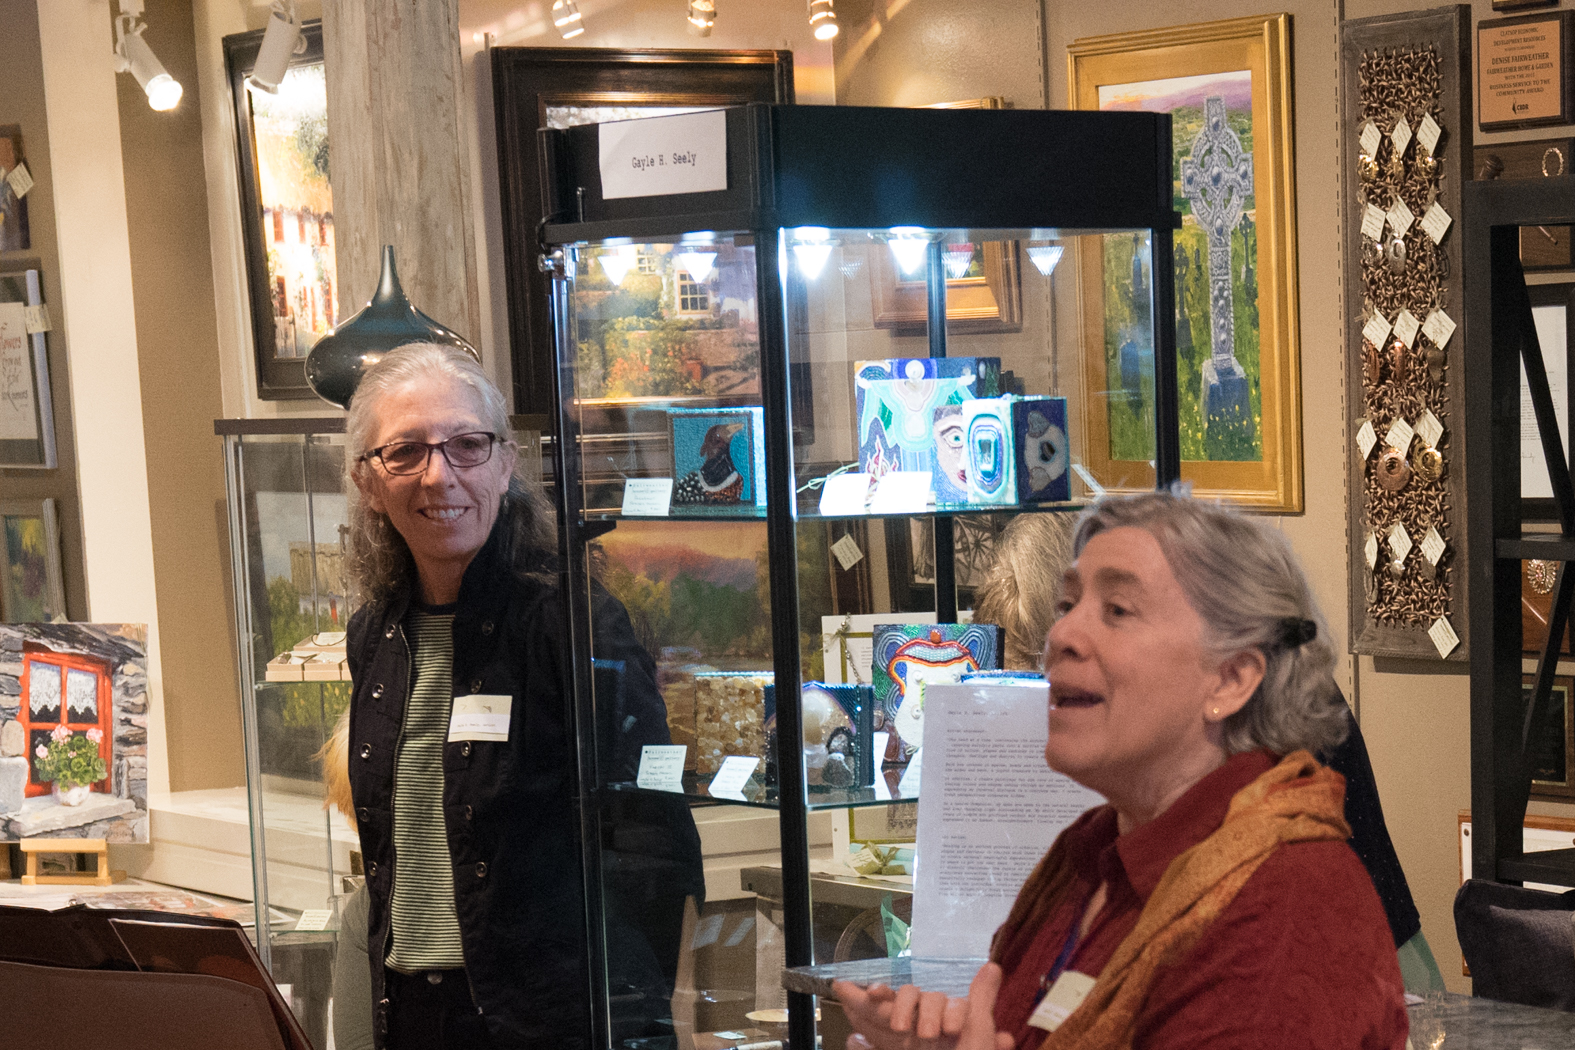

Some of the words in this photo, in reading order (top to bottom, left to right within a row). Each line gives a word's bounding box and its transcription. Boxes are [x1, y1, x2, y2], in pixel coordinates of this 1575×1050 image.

[1492, 56, 1510, 65] DENISE
[1512, 52, 1549, 62] FAIRWEATHER
[1487, 66, 1516, 75] FAIRWEATHER
[1517, 64, 1531, 72] HOME
[1535, 62, 1554, 70] GARDEN
[1495, 89, 1525, 97] COMMUNITY
[631, 155, 655, 171] Gayle
[672, 150, 697, 167] Seely
